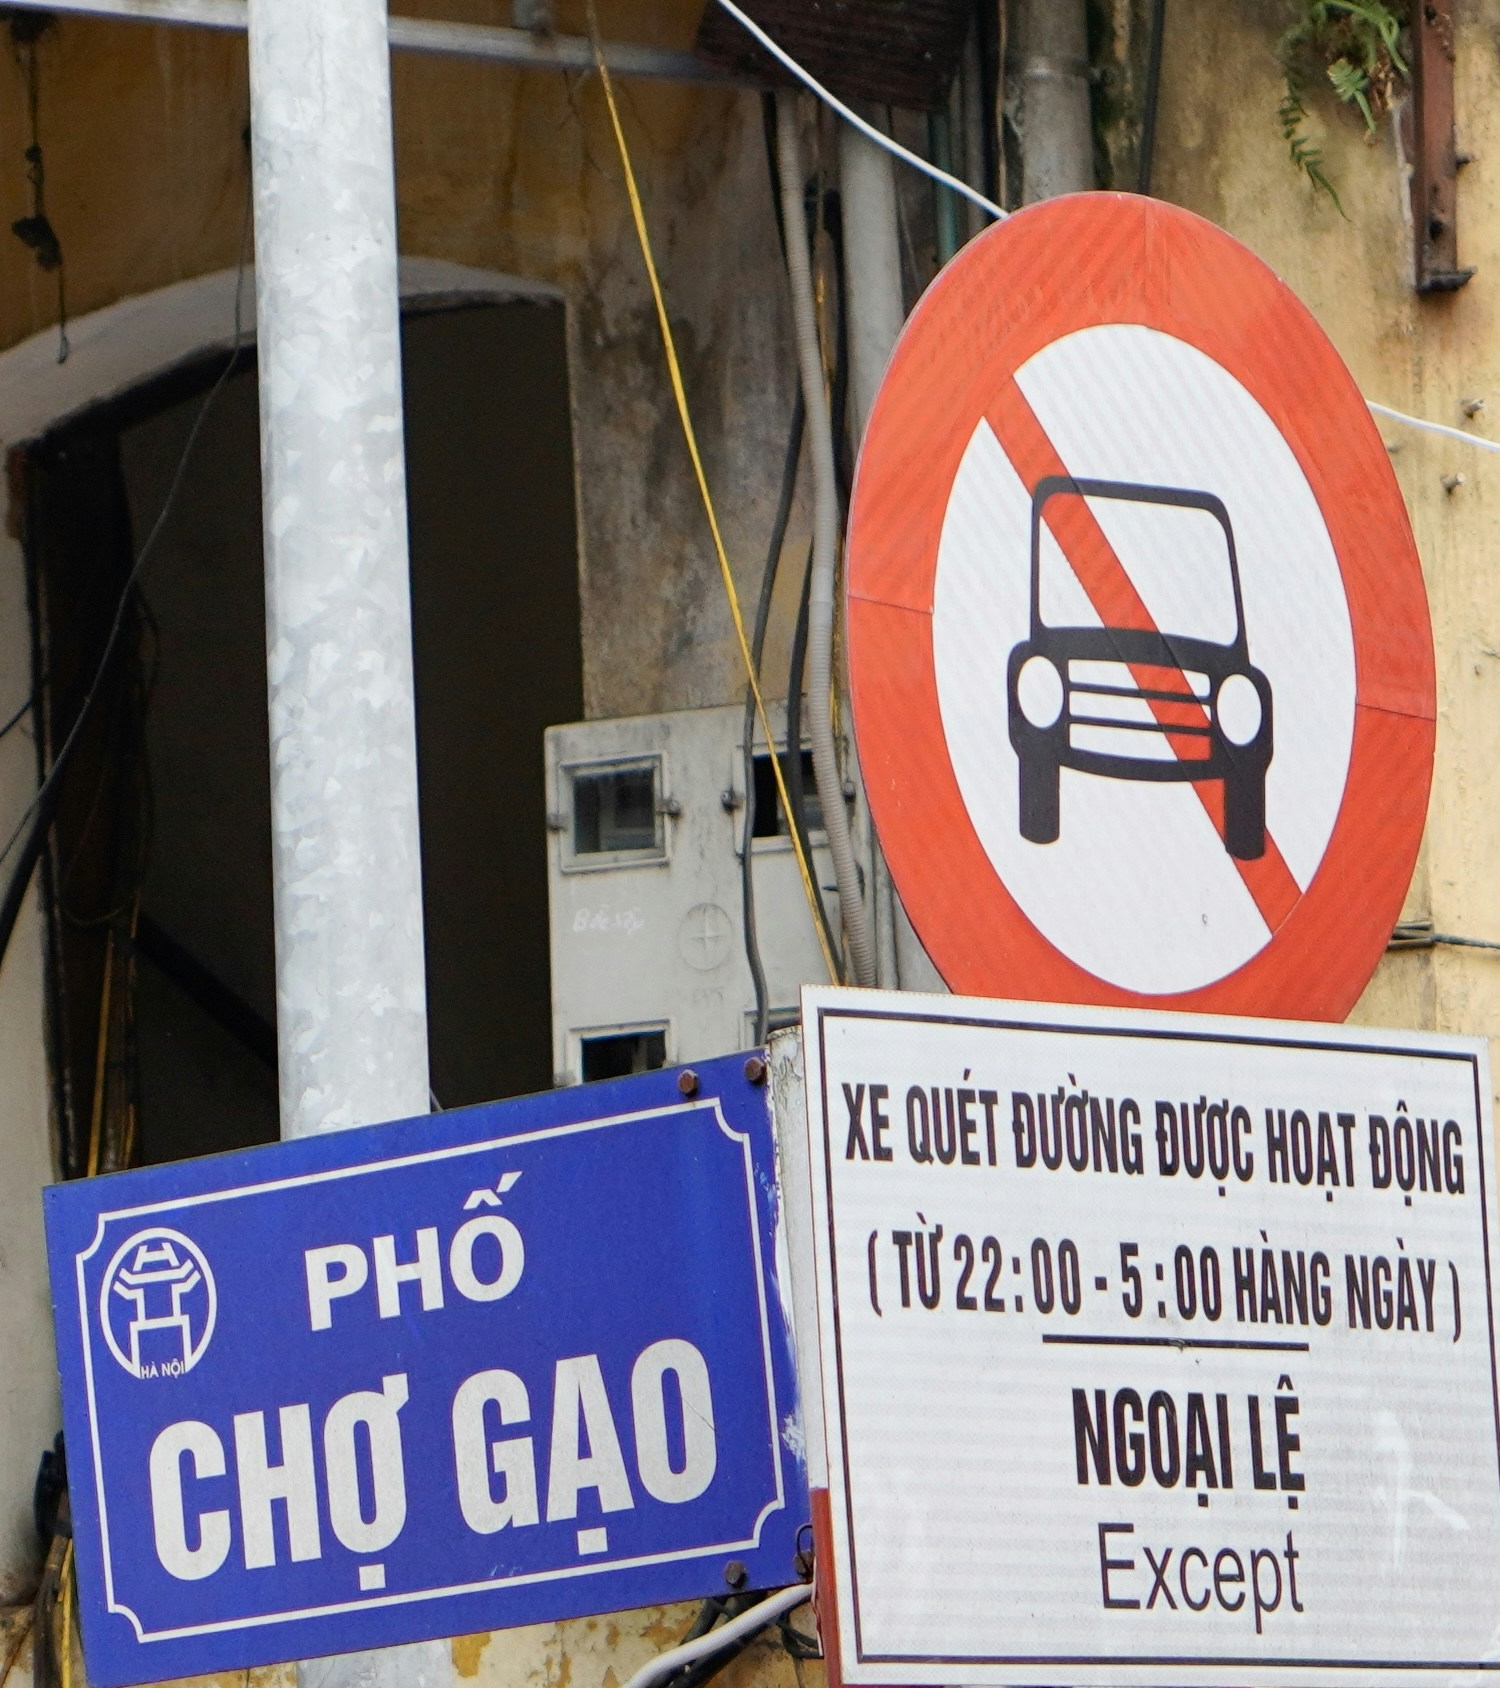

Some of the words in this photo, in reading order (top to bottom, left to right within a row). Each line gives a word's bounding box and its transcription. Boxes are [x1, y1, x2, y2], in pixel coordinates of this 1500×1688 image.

[842, 1080, 891, 1162] XE
[907, 1070, 998, 1165] QUÉT
[1012, 1074, 1143, 1174] ĐƯỜNG
[1155, 1097, 1255, 1197] ĐƯỢC
[1265, 1107, 1357, 1201] HOẠT
[1368, 1101, 1466, 1205] ĐỘNG
[304, 1171, 526, 1332] PHỐ
[1235, 1232, 1332, 1327] HÀNG
[140, 1361, 159, 1379] HÀ
[161, 1358, 185, 1379] NỘI
[147, 1372, 409, 1591] CHỢ
[450, 1337, 718, 1556] GẠO
[1073, 1385, 1229, 1508] NGOẠI
[1251, 1375, 1302, 1508] LỆ
[1103, 1522, 1304, 1635] Except
